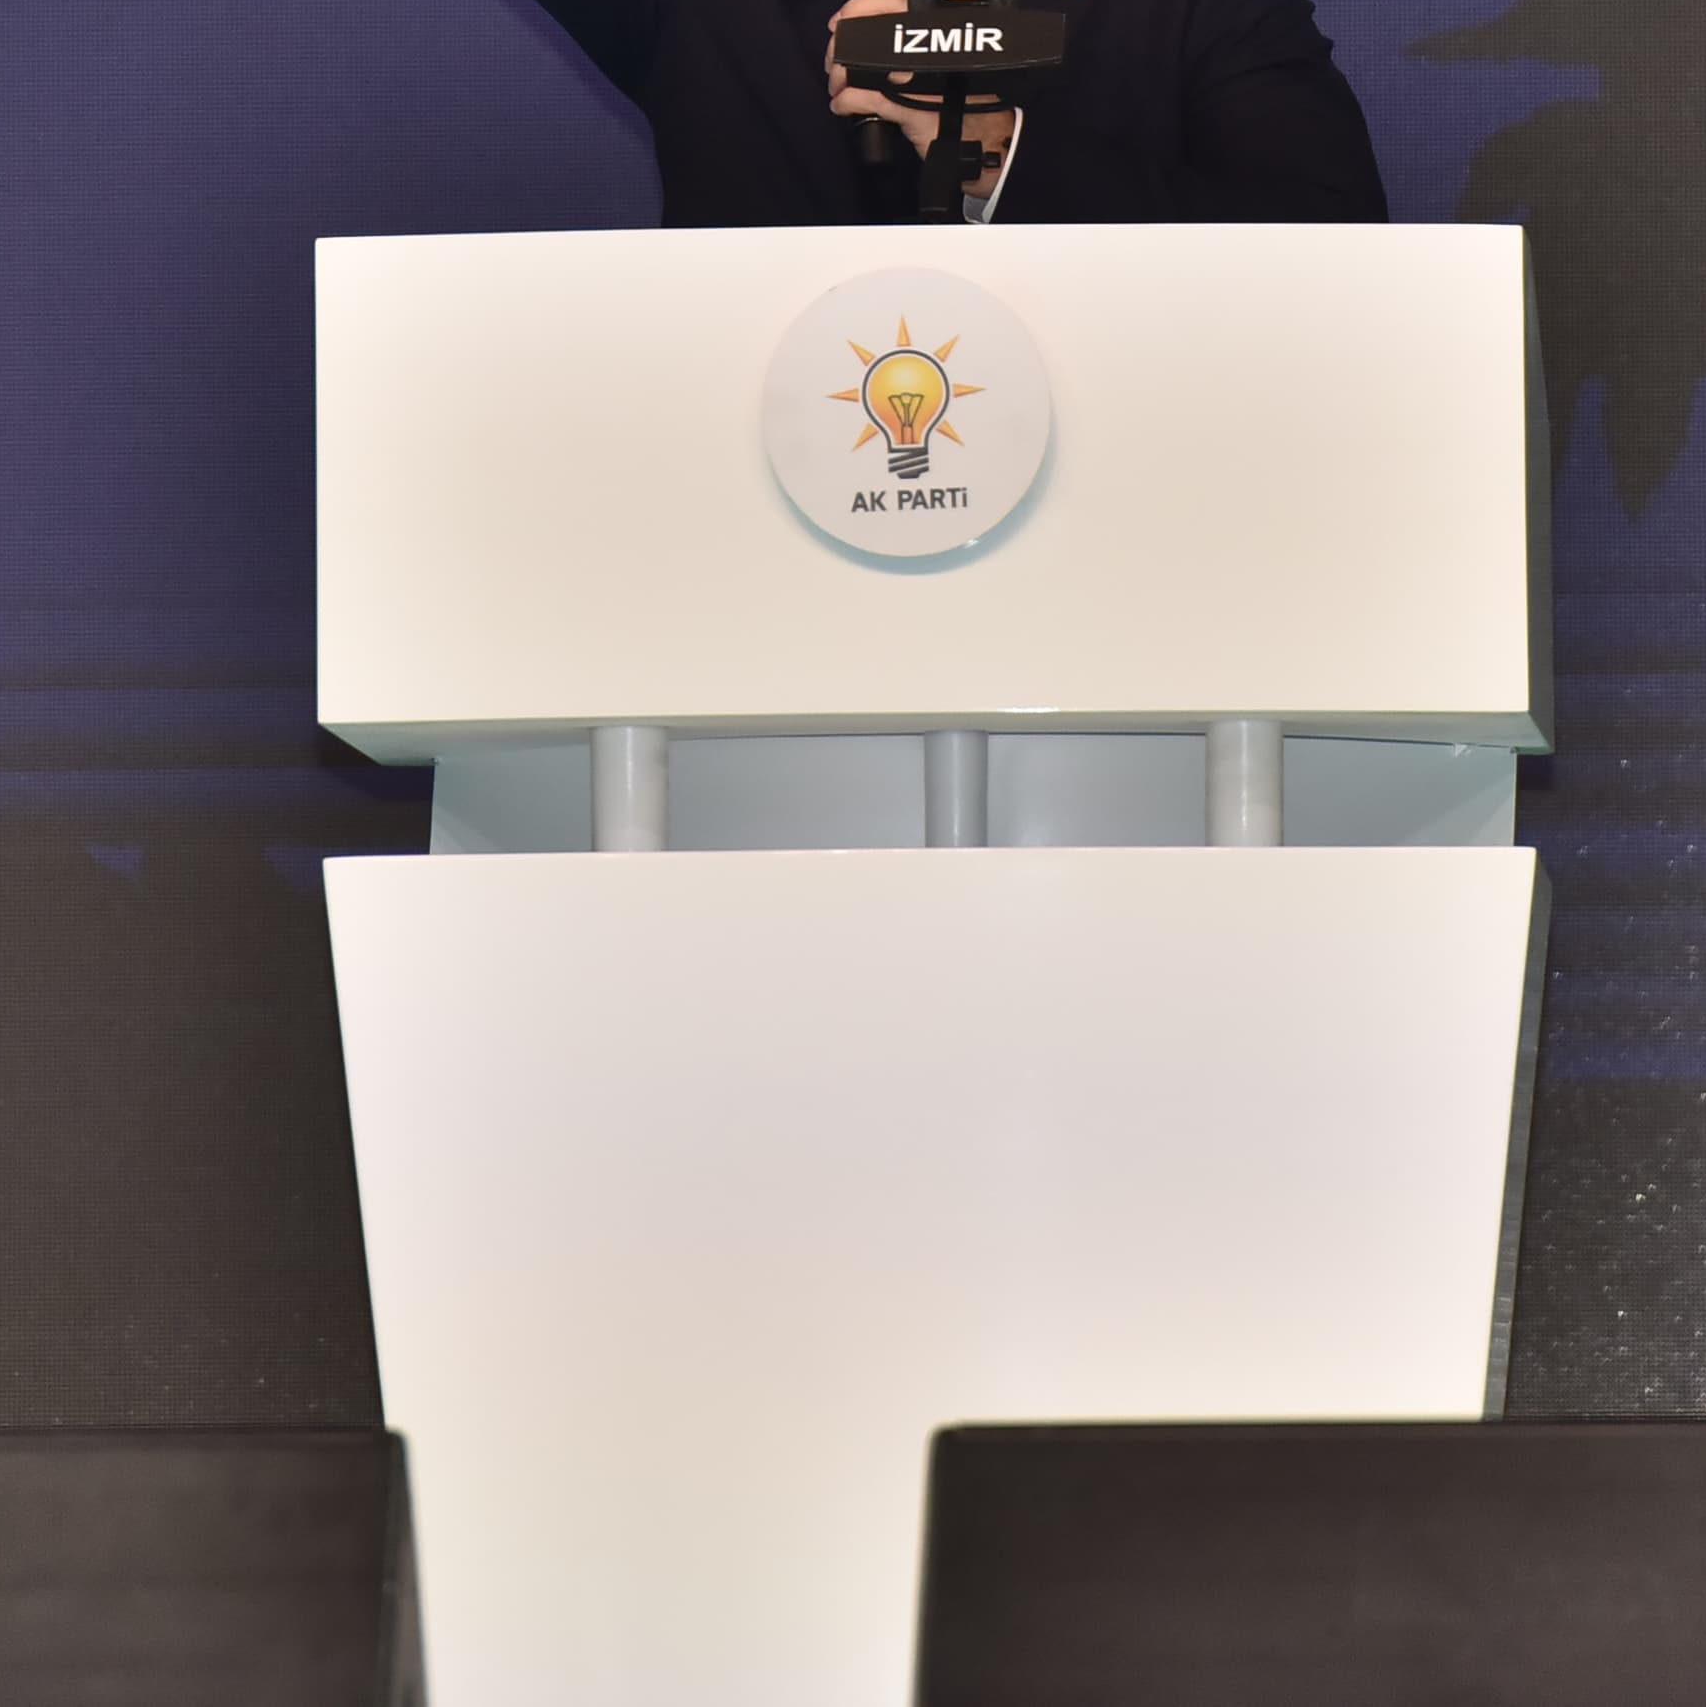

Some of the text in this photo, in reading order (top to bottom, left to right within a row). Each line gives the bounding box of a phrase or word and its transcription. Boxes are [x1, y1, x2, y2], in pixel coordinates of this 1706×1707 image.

[893, 22, 1003, 54] İZMİR
[851, 487, 969, 513] AK PARTİ
